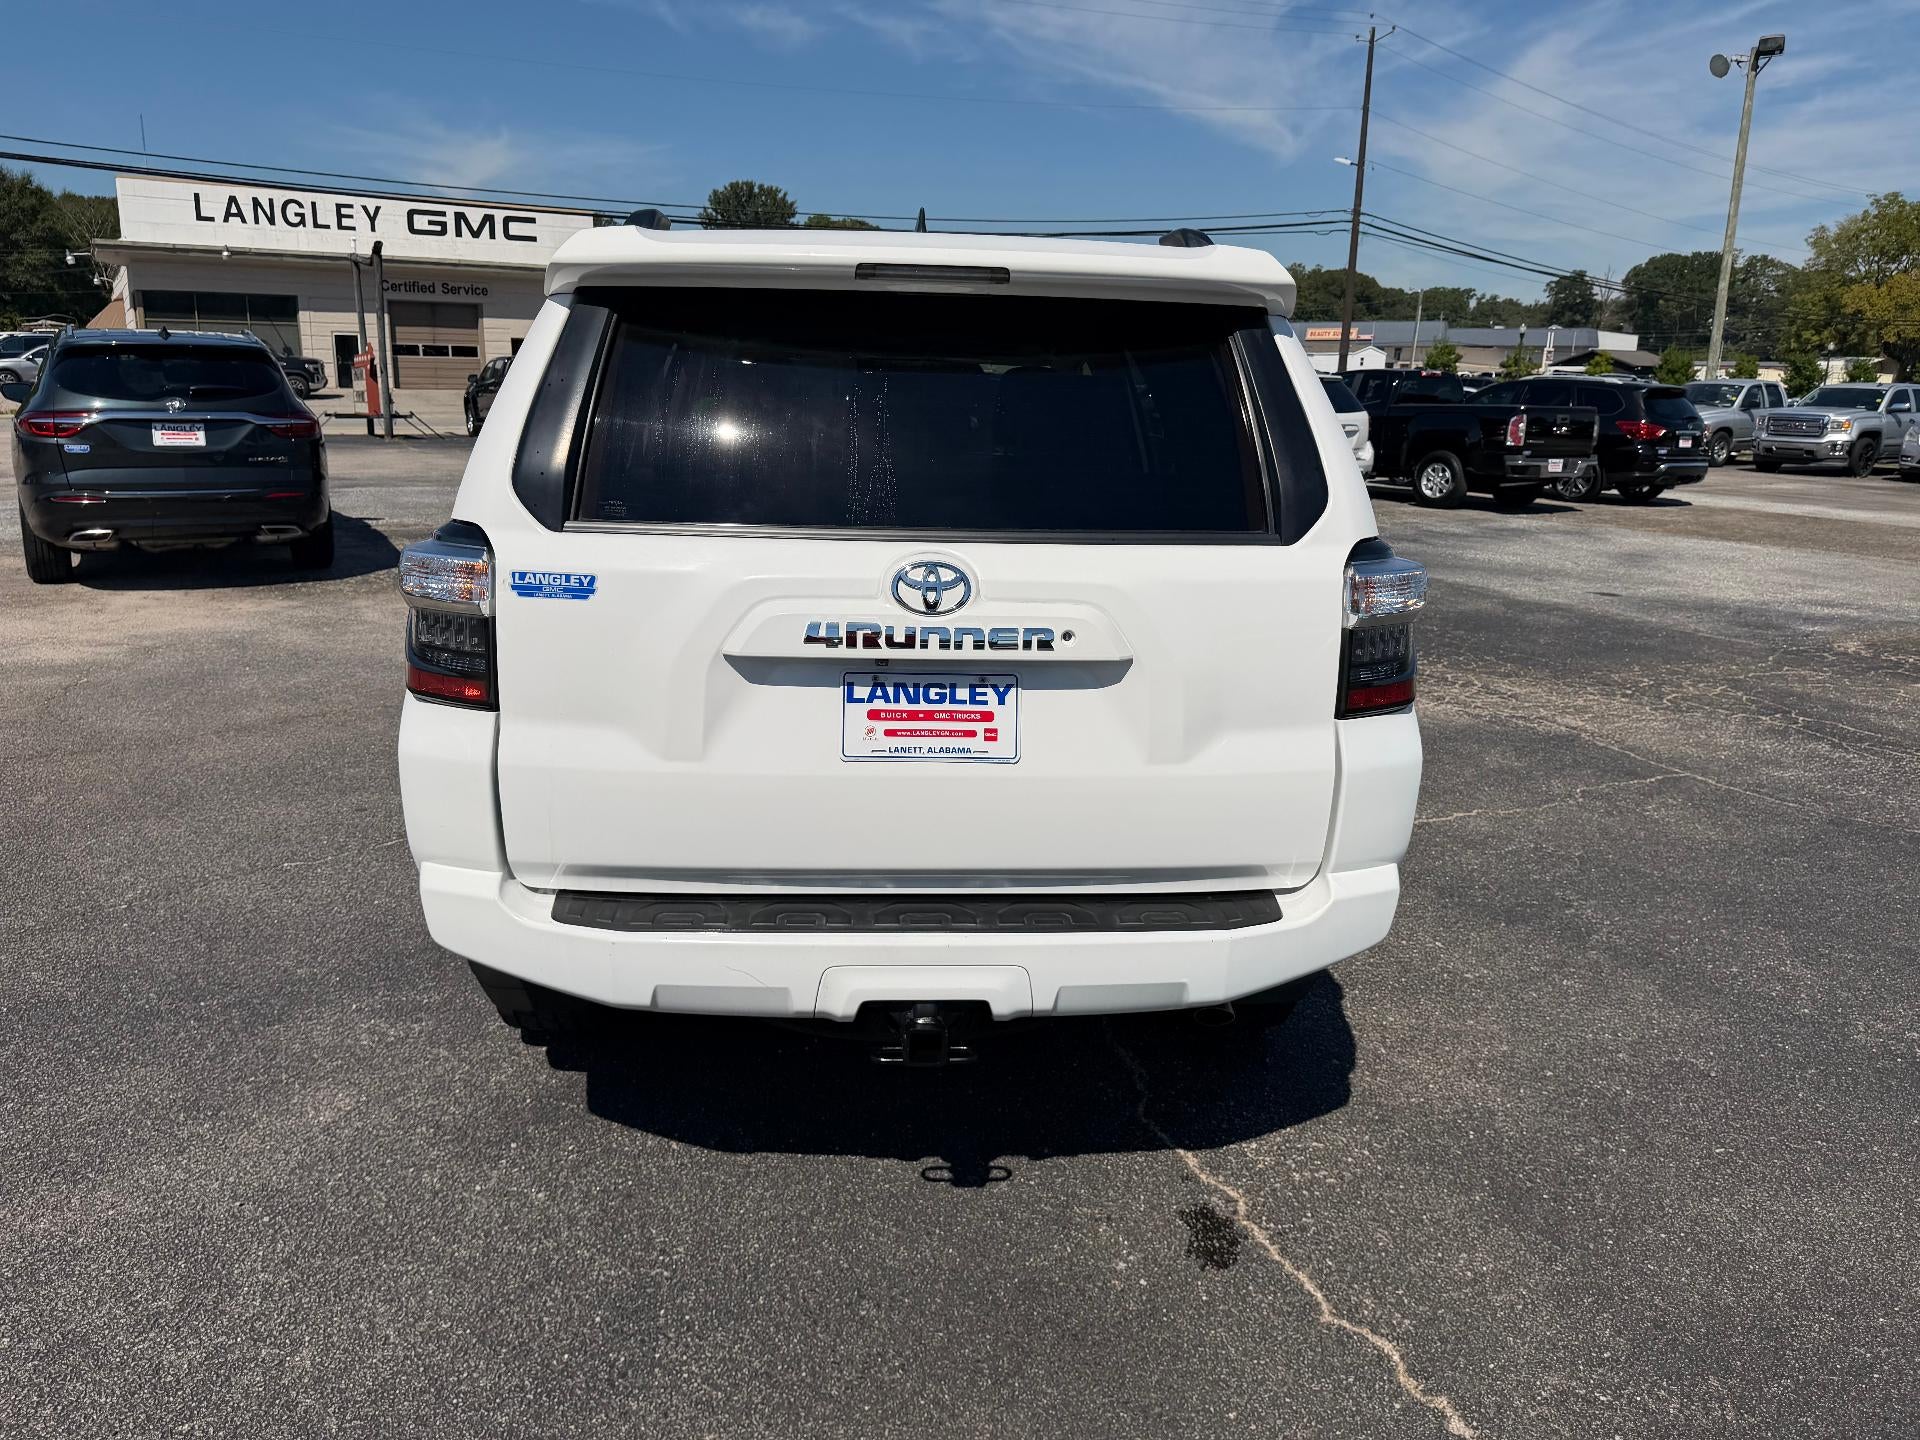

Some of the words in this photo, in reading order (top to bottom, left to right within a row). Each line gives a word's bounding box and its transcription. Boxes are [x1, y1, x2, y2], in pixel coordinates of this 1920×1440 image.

[194, 192, 382, 233] LANGLEY
[406, 208, 538, 242] GMC
[382, 280, 436, 294] Certified
[441, 282, 489, 296] Service
[154, 424, 202, 432] LANGLEY
[514, 572, 592, 587] LANGLEY
[803, 621, 1055, 651] 4RUNNER
[846, 681, 1016, 706] LANGLEY
[888, 746, 925, 754] LANETT,
[926, 746, 972, 754] ALABAMA
